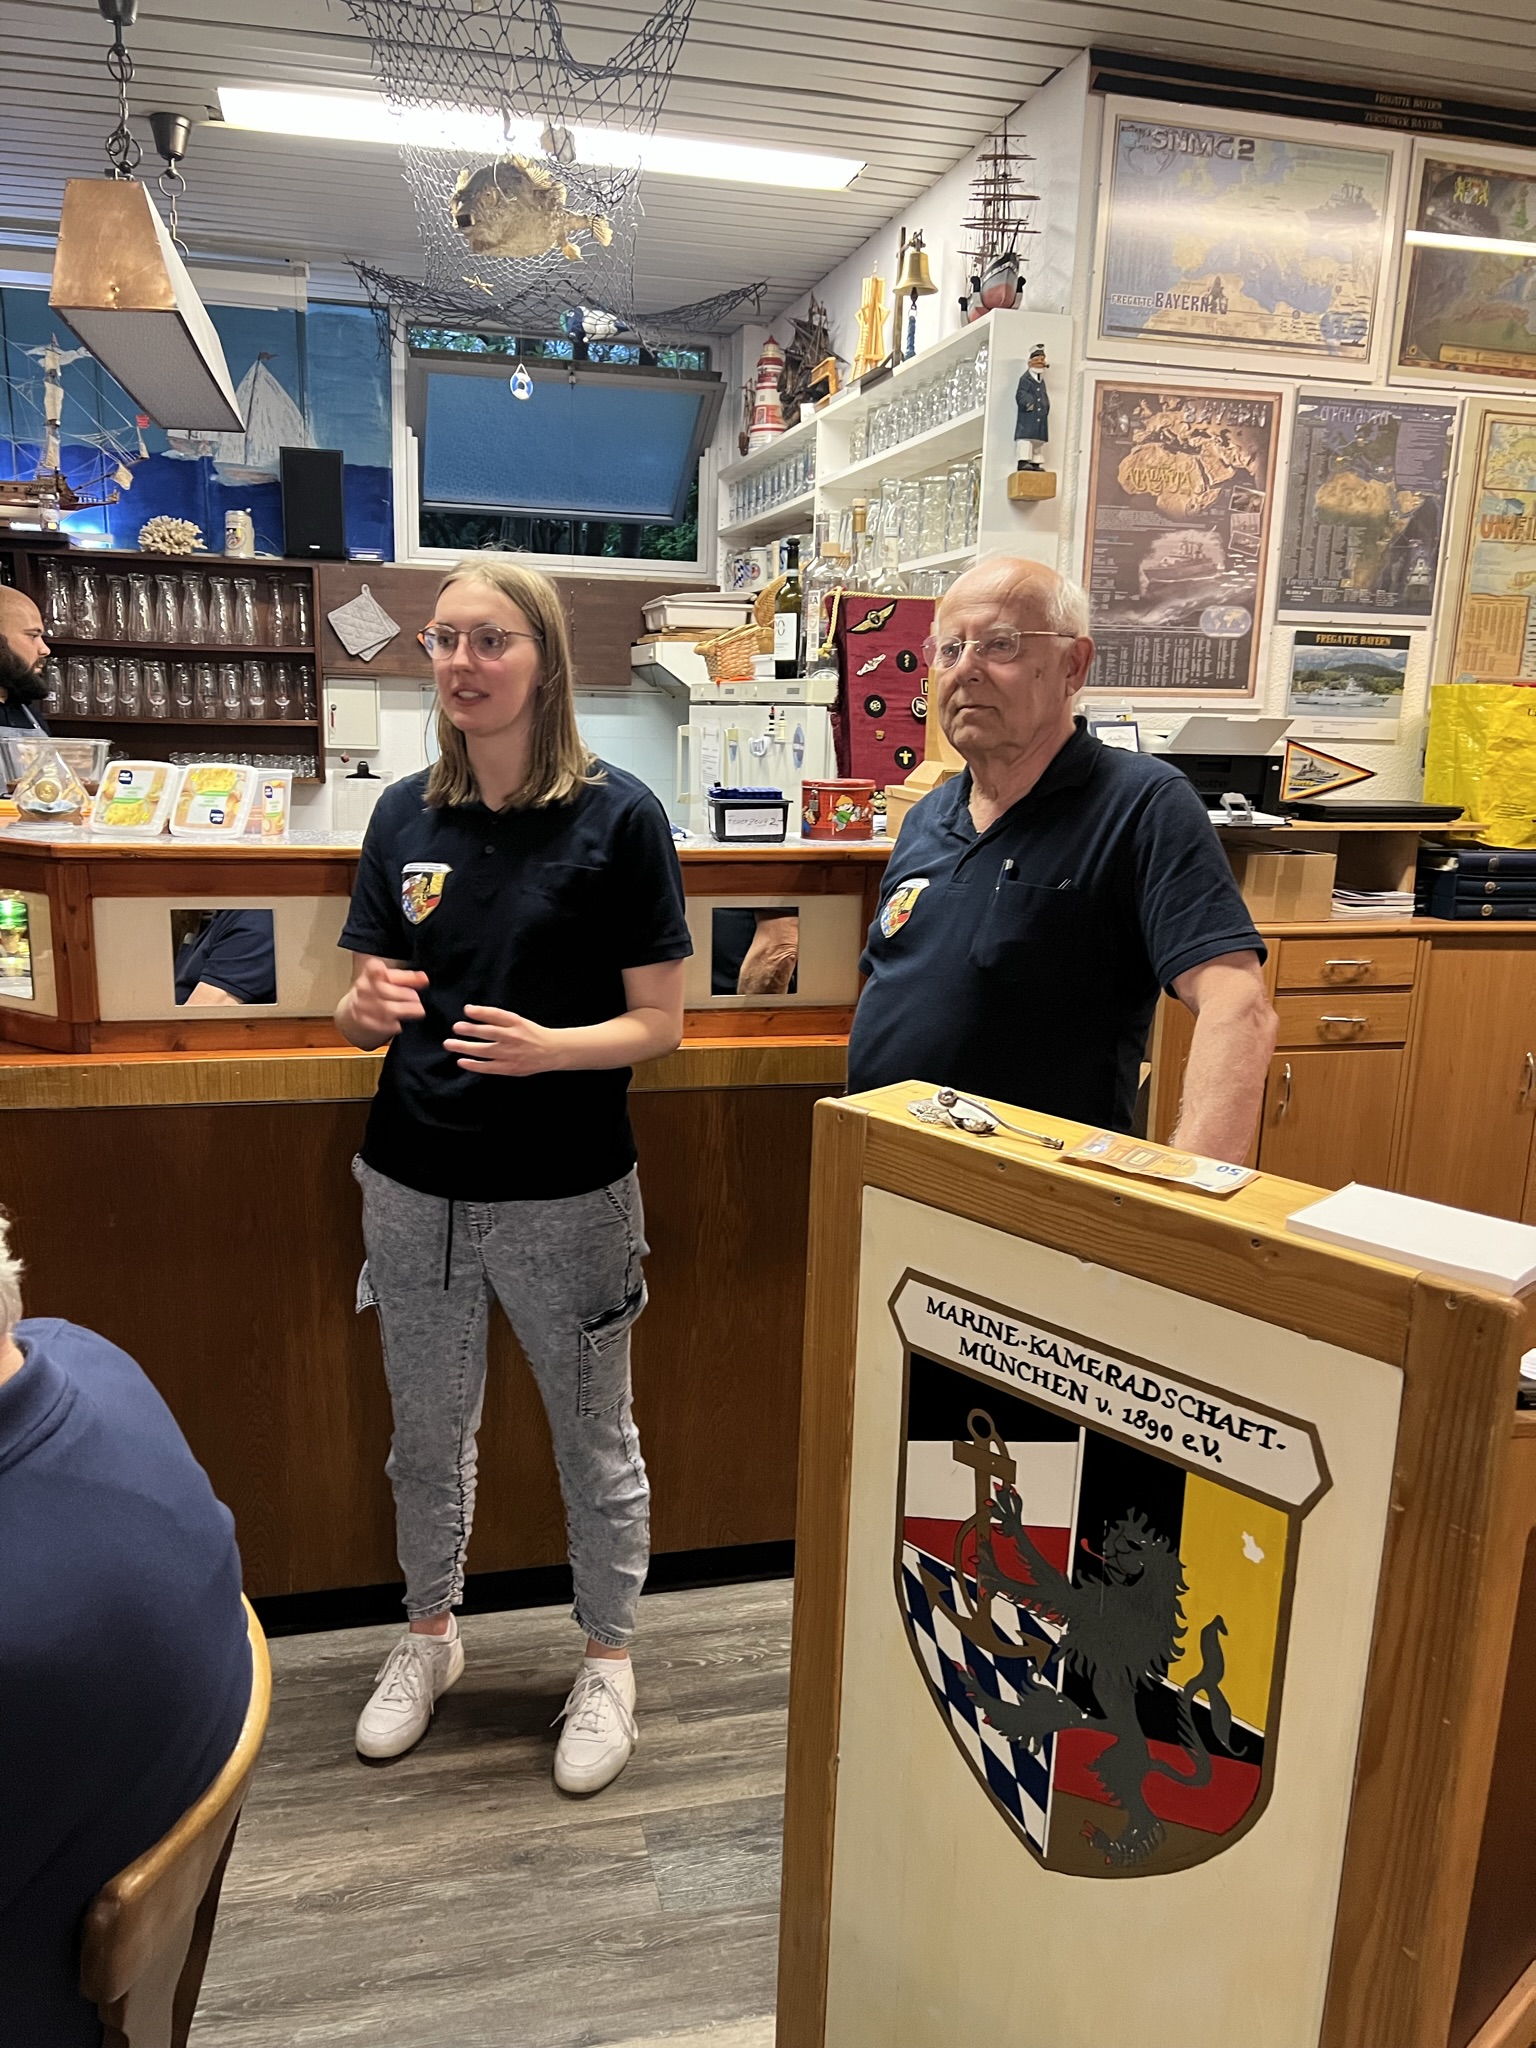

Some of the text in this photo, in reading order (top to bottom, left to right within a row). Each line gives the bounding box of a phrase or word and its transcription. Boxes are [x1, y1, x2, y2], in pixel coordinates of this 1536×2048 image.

[1237, 138, 1256, 162] 2
[1155, 291, 1210, 313] BAYERN
[1320, 405, 1393, 425] ATALANTA
[1315, 633, 1392, 646] FREGATTE BAYERN
[959, 1336, 1089, 1405] MÜNCHEN
[1121, 1408, 1173, 1443] 1890
